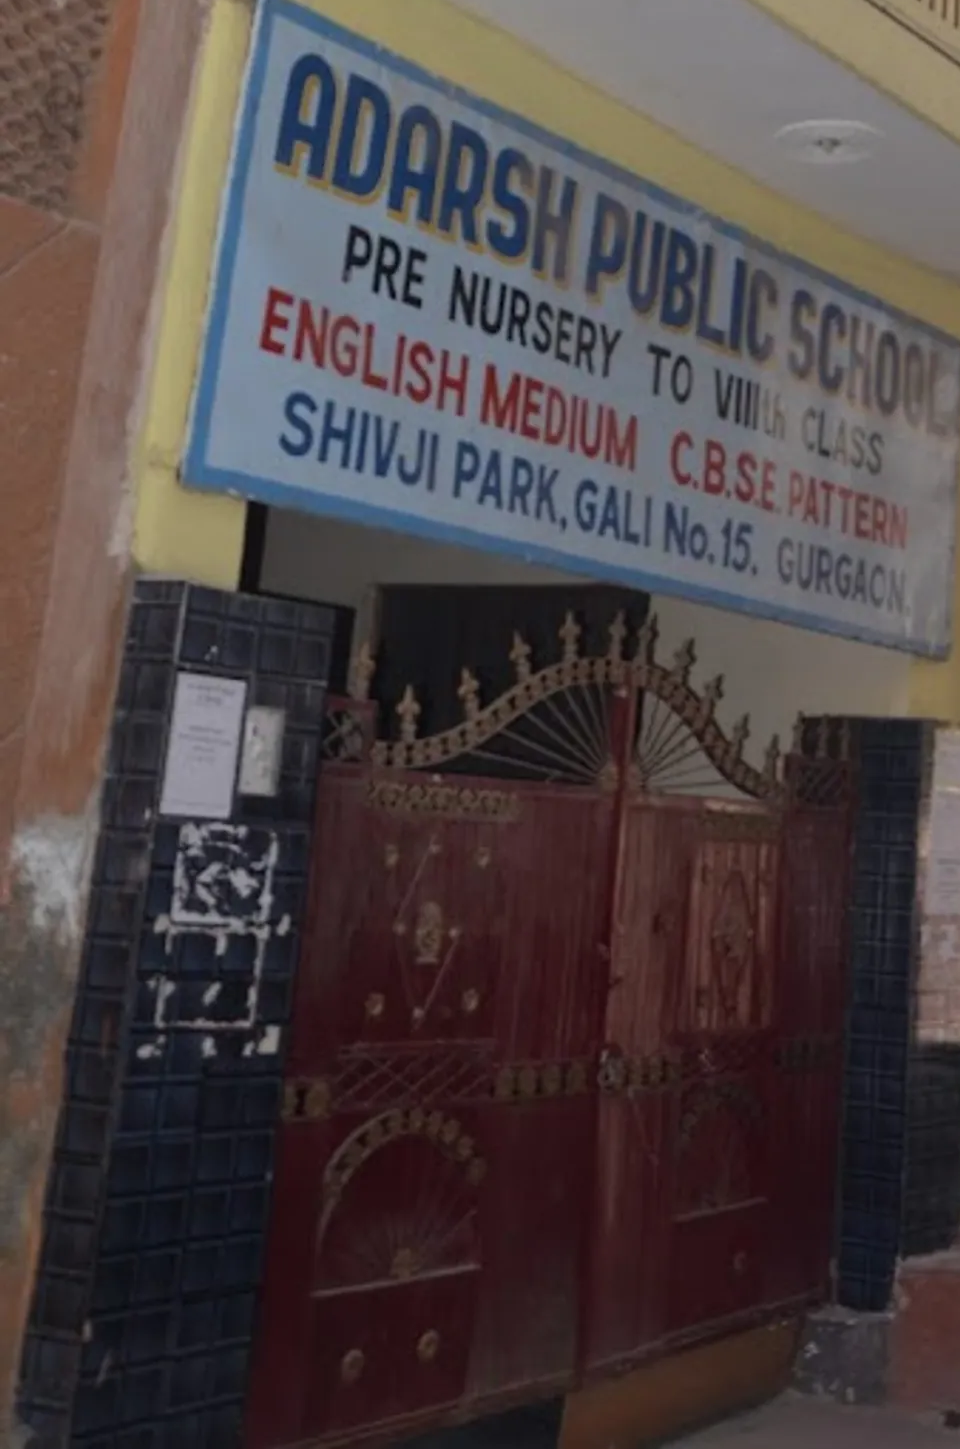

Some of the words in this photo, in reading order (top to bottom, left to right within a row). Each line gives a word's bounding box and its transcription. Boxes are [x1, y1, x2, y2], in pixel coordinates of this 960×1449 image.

[274, 53, 580, 290] ADARSH
[584, 191, 780, 365] PUBLIC
[258, 287, 469, 418] ENGLISH
[479, 363, 638, 472] MEDIUM
[788, 470, 909, 550] PATTERN
[278, 390, 439, 493] SHIVJI
[341, 224, 427, 308] PRE
[447, 266, 623, 379] NURSERY
[647, 344, 694, 404] TO
[801, 411, 885, 476] CLASS
